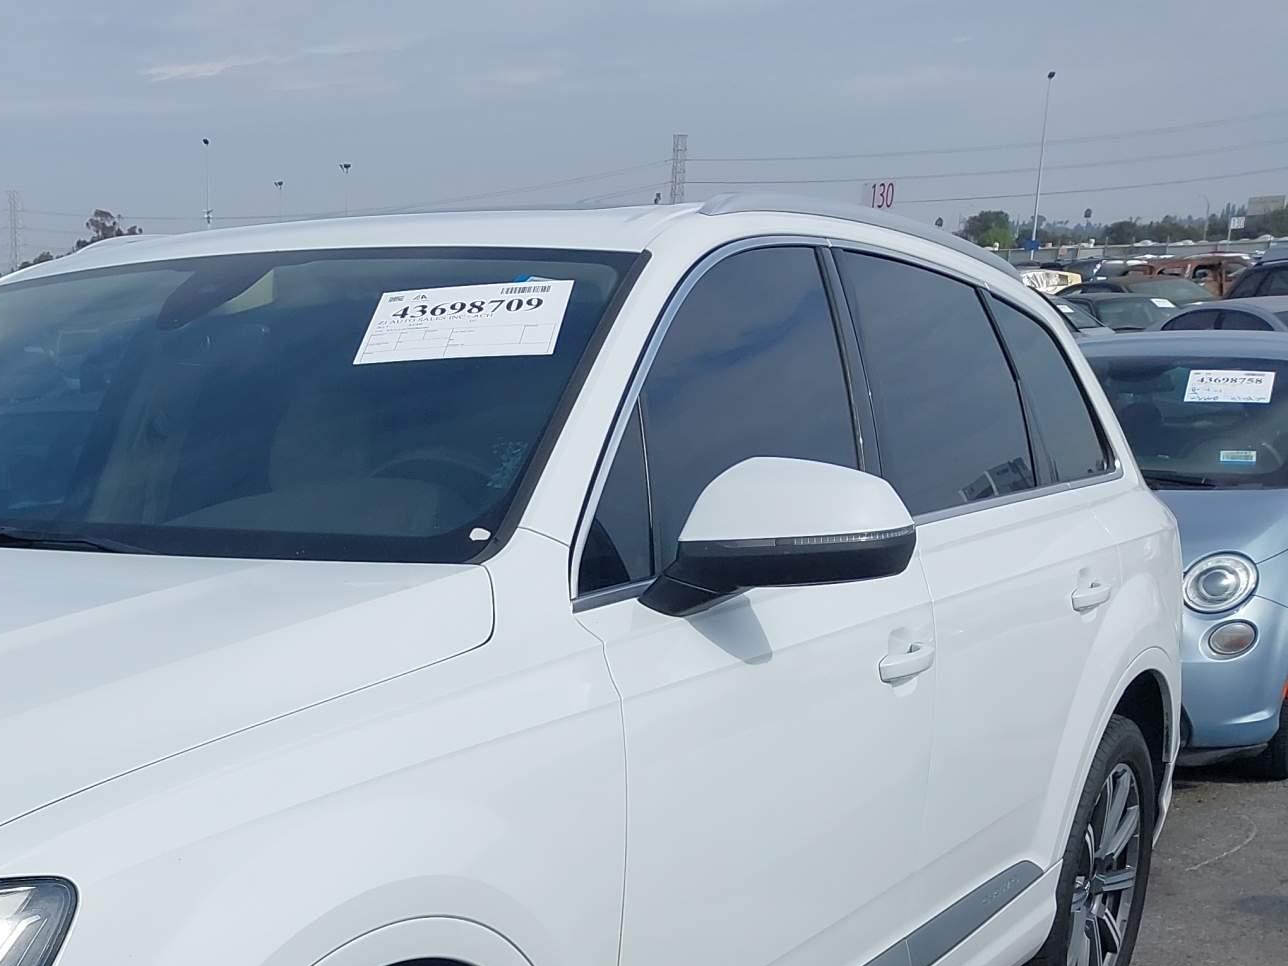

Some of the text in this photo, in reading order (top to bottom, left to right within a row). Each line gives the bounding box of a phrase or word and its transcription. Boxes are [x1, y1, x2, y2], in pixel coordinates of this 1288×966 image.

[872, 183, 894, 208] 130
[391, 297, 544, 319] 43698709
[1197, 376, 1263, 384] 43698758
